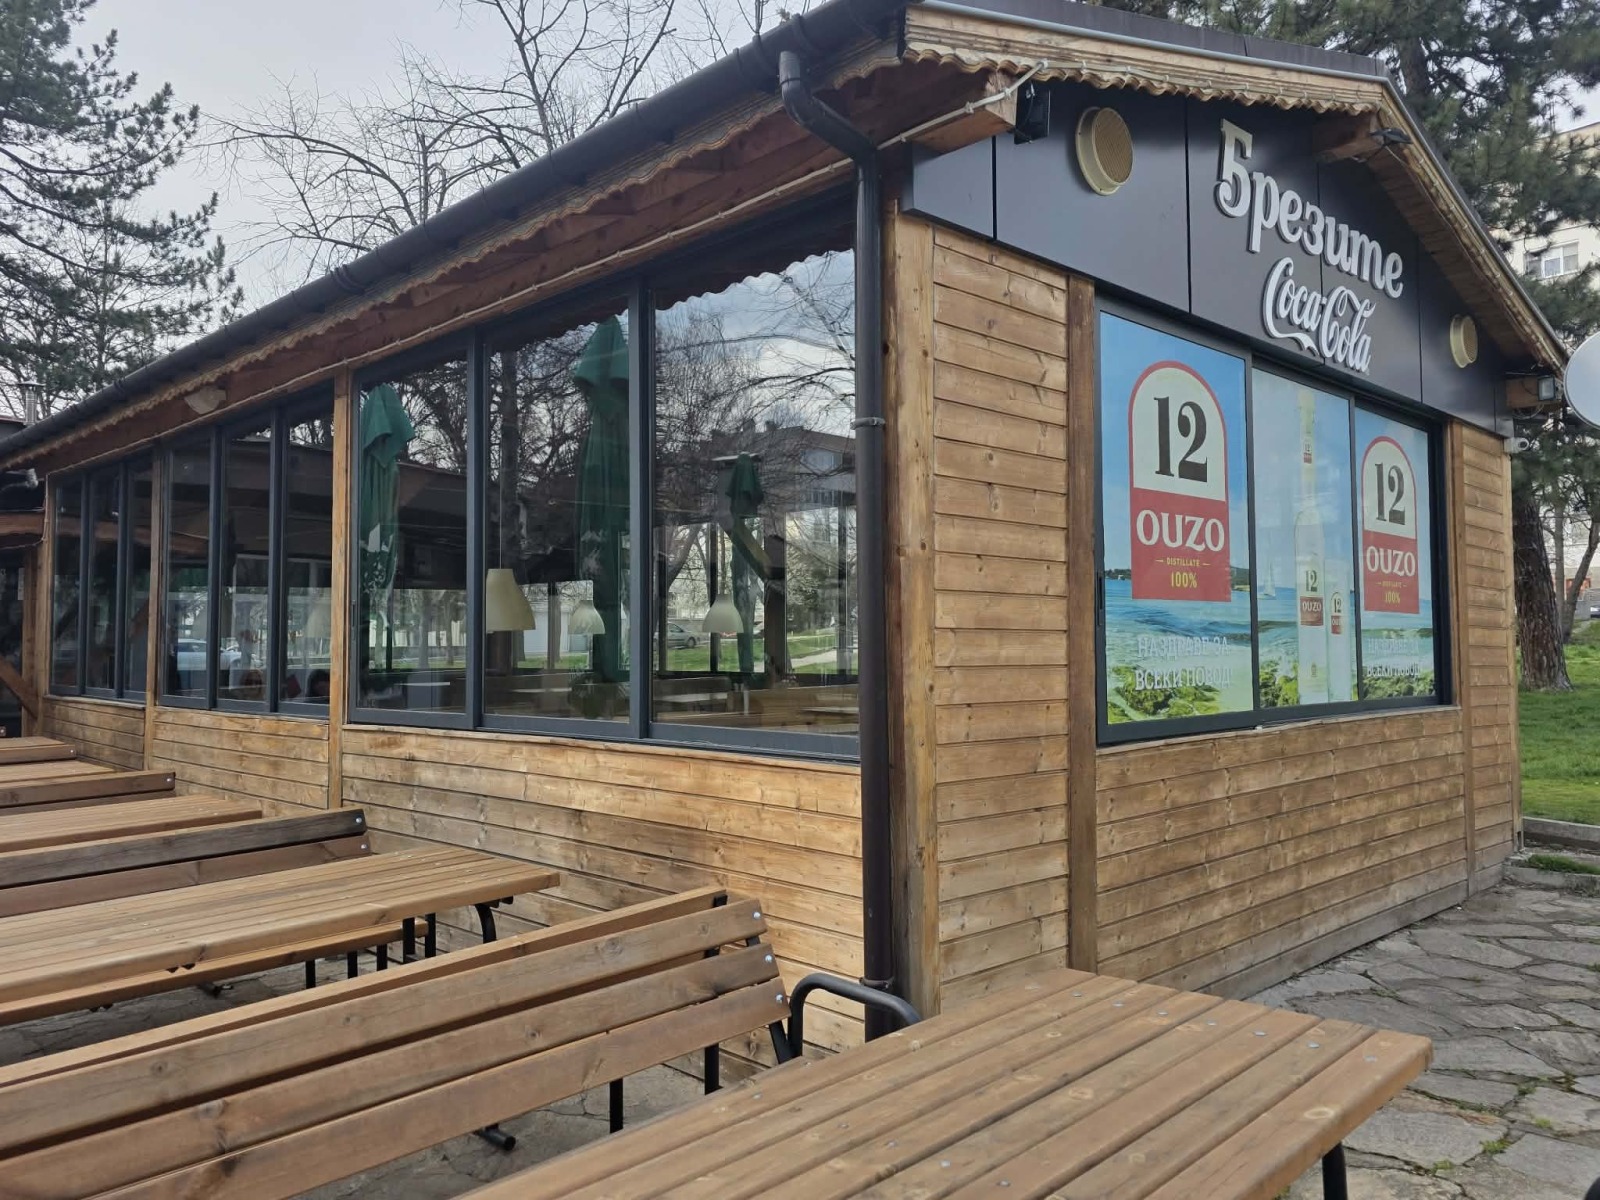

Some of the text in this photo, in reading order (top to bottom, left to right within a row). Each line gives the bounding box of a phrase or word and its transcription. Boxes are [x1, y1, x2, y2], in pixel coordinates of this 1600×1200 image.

[1214, 118, 1403, 298] Брезите
[1153, 396, 1208, 483] 12
[1374, 462, 1406, 526] 12
[1136, 509, 1225, 552] OUZO
[1166, 557, 1201, 567] DISTILLATE
[1366, 545, 1416, 577] OUZO
[1170, 571, 1198, 588] 100%
[1305, 570, 1318, 592] 12
[1302, 601, 1322, 612] OUZO
[1333, 598, 1342, 613] 12
[1385, 590, 1401, 604] 100%
[1135, 668, 1183, 690] ВСЕКИ
